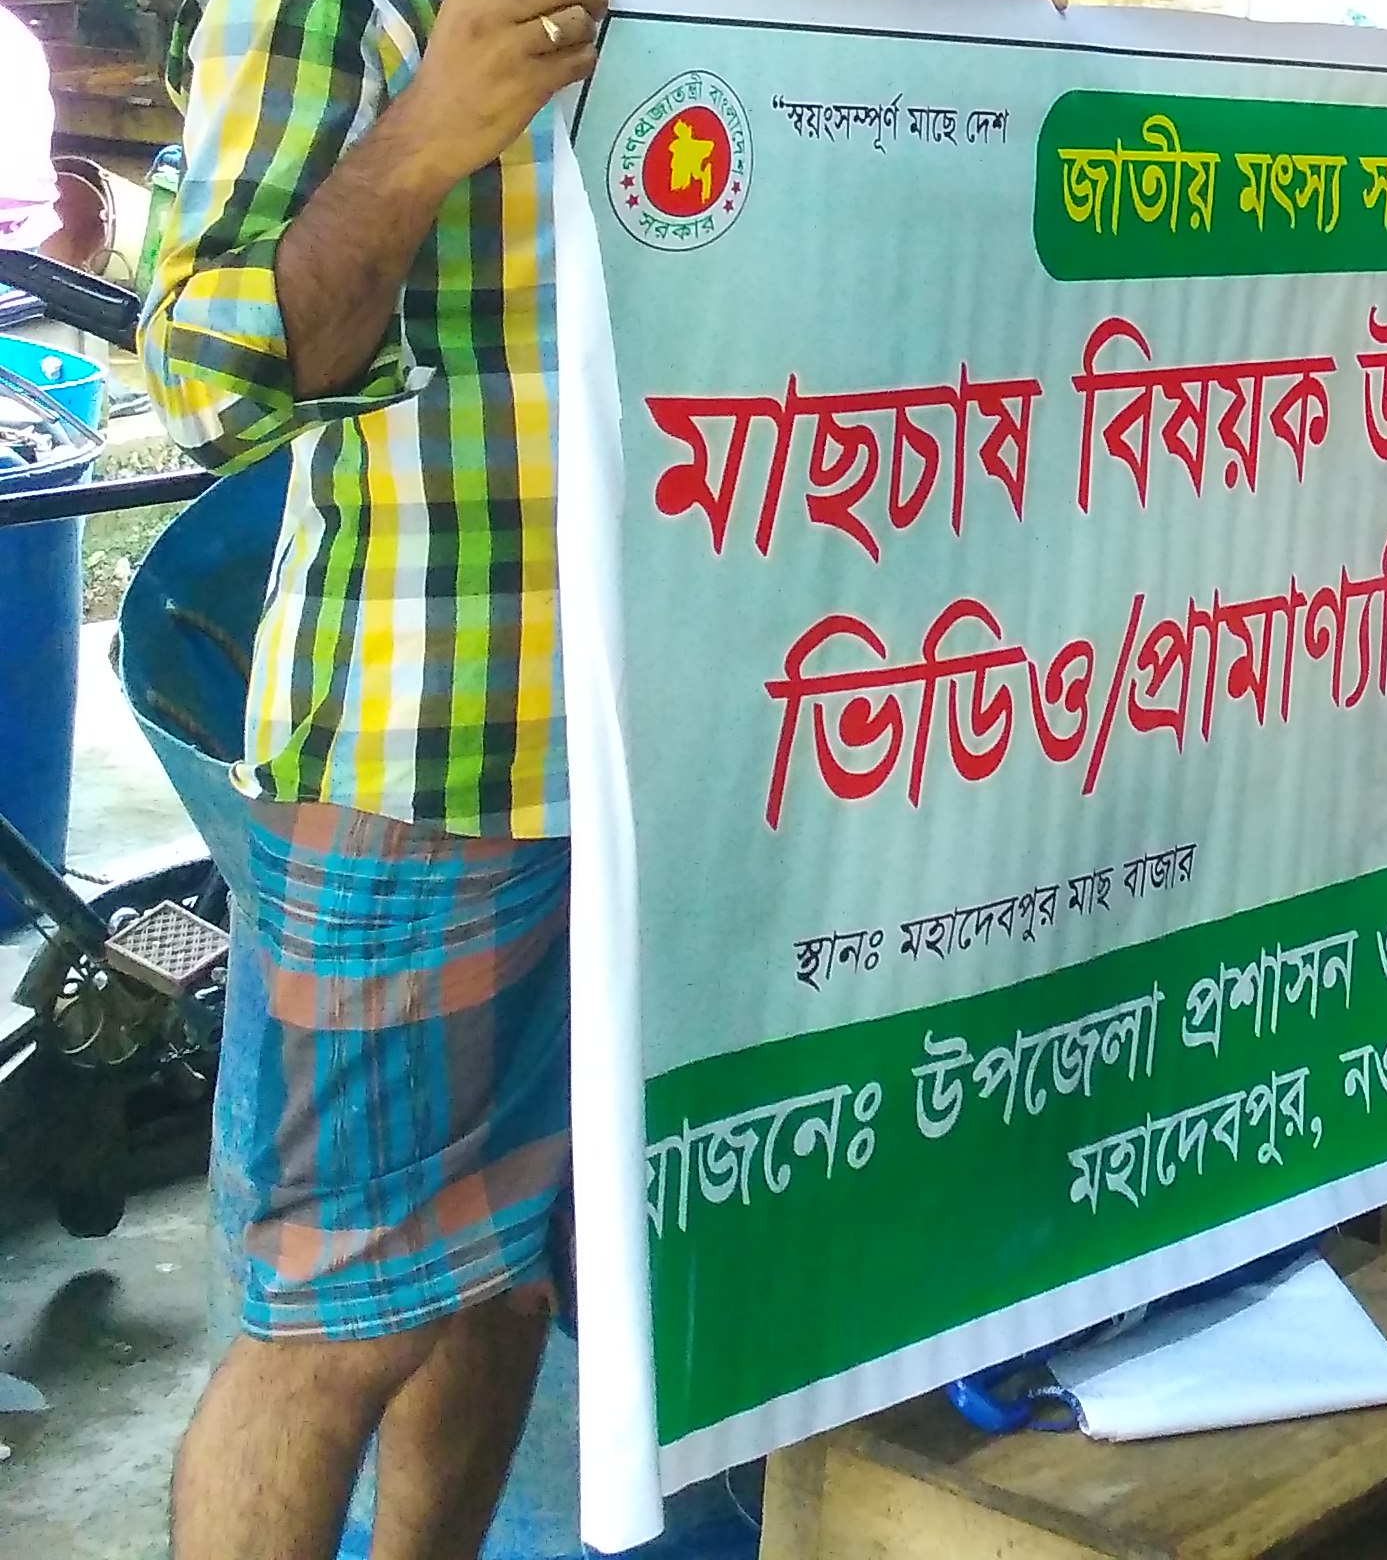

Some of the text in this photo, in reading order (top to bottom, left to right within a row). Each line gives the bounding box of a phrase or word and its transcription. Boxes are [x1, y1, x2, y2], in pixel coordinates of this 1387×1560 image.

[908, 106, 958, 146] মাছে
[967, 109, 1010, 144] দেশ
[1057, 115, 1221, 236] জাতীয়
[1235, 152, 1346, 235] মৎস্য
[639, 210, 716, 240] সরকার
[645, 362, 1042, 564] মাছচাষ
[1072, 317, 1336, 515] বিষয়ক
[793, 842, 1198, 992] স্থানঃ মহাদেবপুর মাছ বাজার
[913, 980, 1165, 1139] উপজেলা
[1181, 929, 1359, 1057] প্রশাসন
[1068, 1067, 1324, 1215] মহাদেবপুর,
